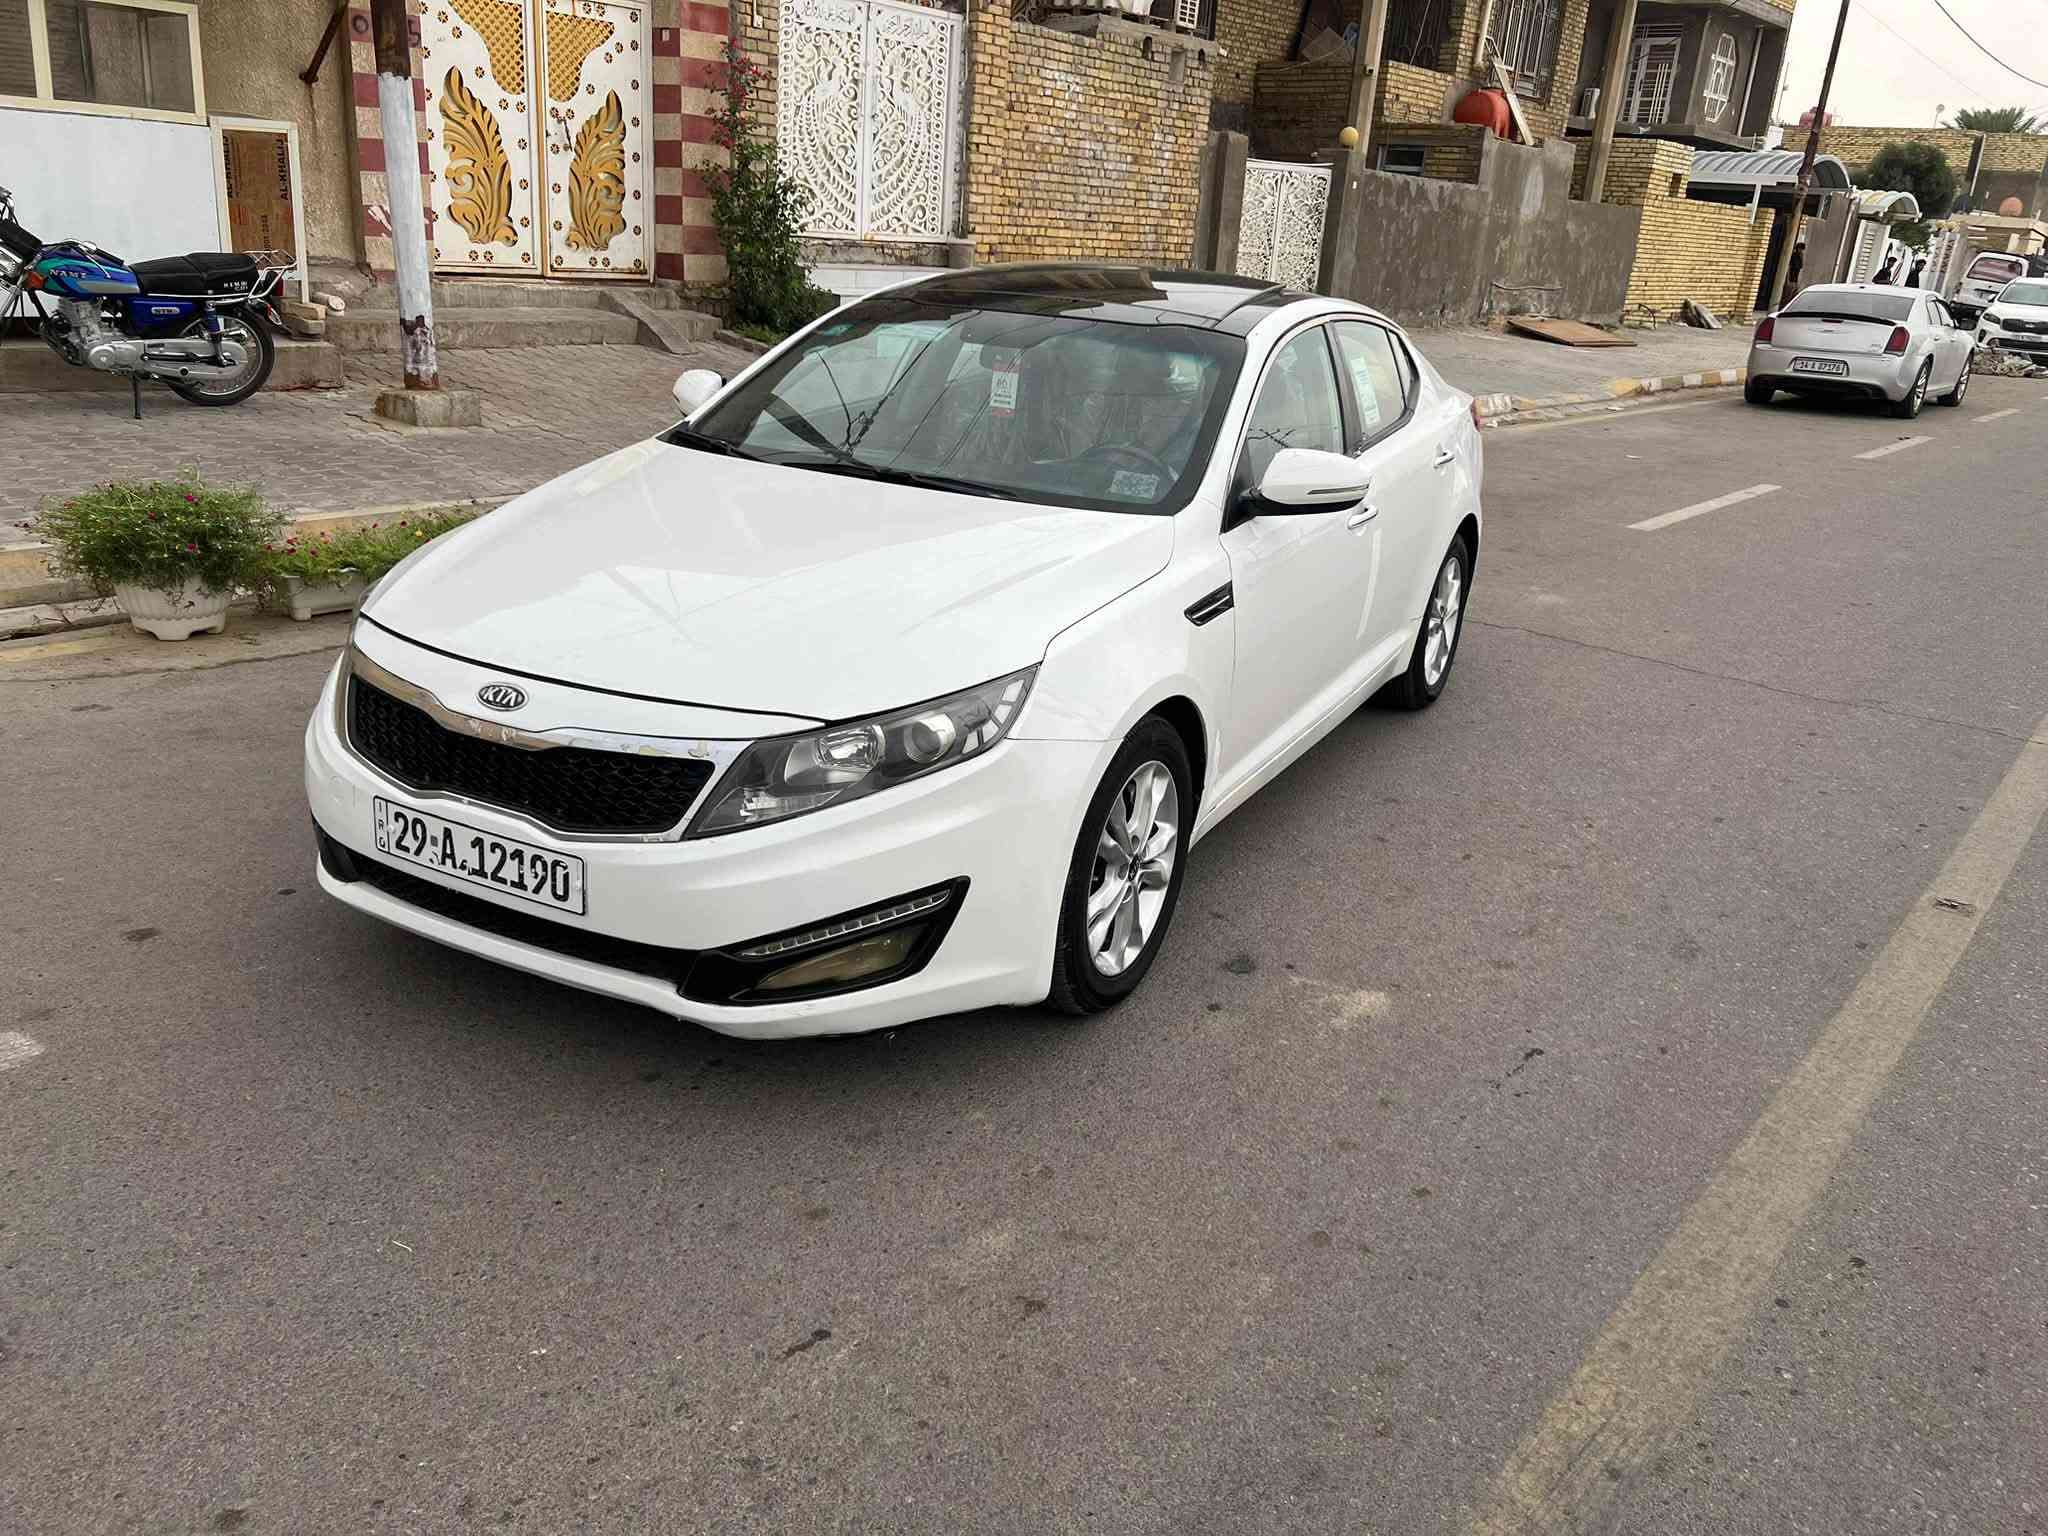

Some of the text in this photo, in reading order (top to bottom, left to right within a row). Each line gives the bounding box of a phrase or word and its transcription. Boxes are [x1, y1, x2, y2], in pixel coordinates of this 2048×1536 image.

[482, 685, 518, 707] KIA
[394, 811, 569, 902] 29 A 12190
